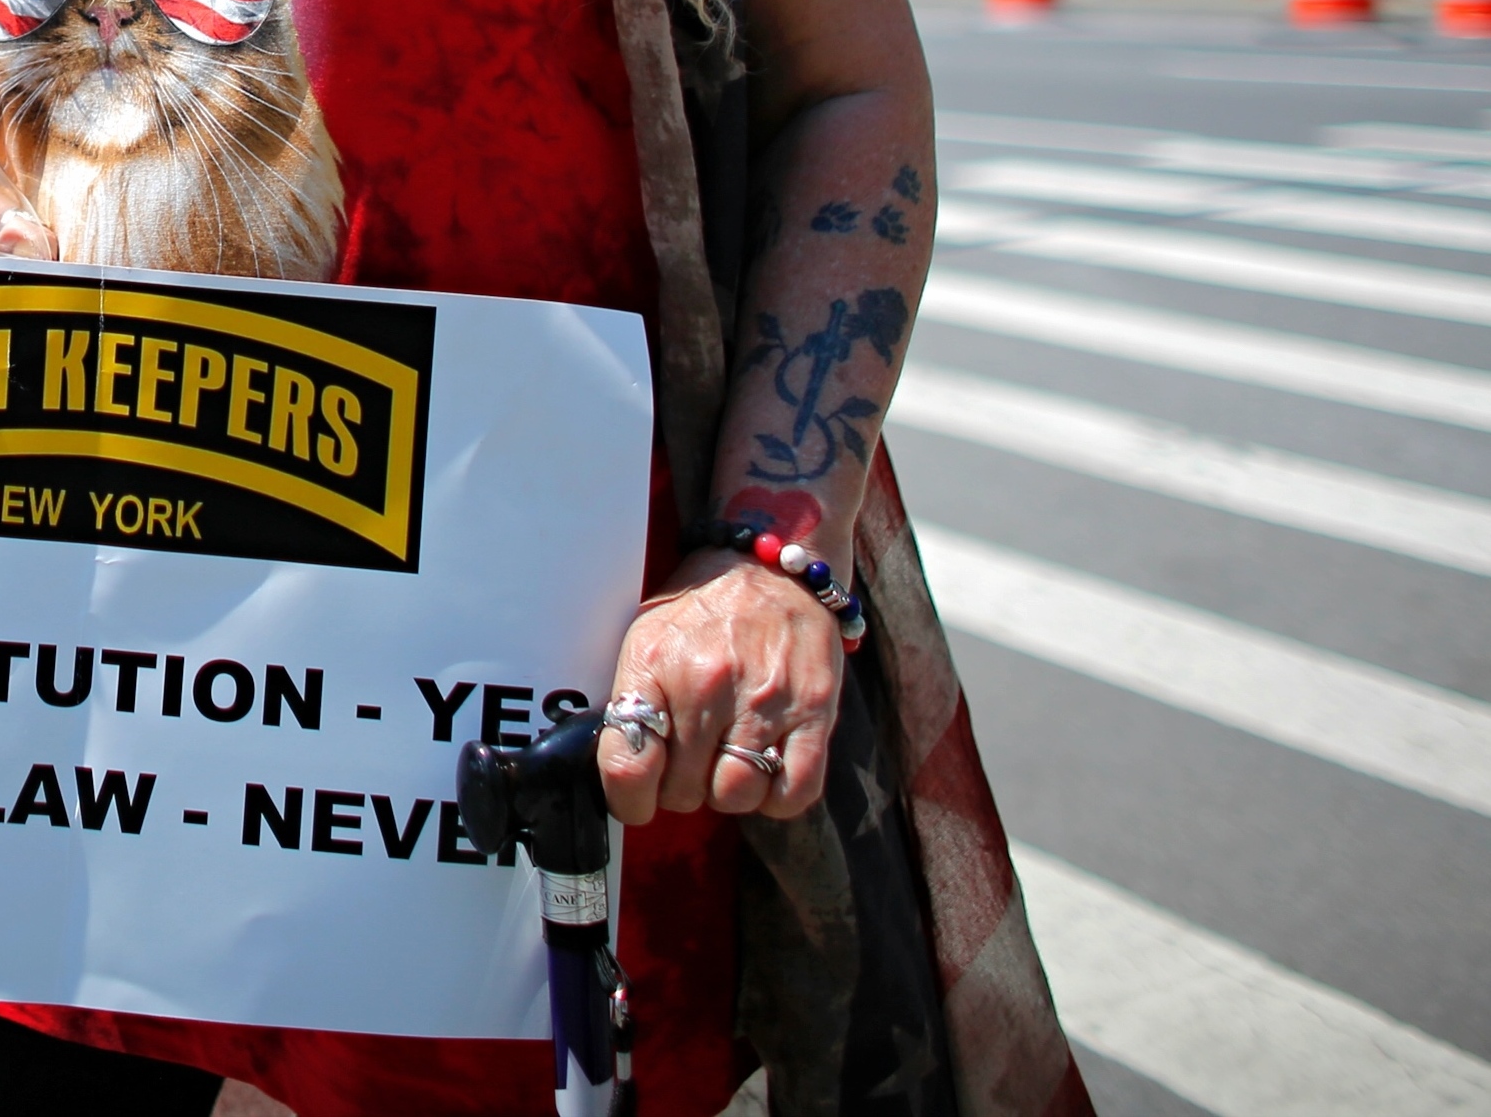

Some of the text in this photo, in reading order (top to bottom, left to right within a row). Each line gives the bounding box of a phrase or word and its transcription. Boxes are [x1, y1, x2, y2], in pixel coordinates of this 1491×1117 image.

[42, 328, 362, 477] KEEPERS
[90, 493, 202, 540] YORK
[242, 783, 537, 868] NEVE
